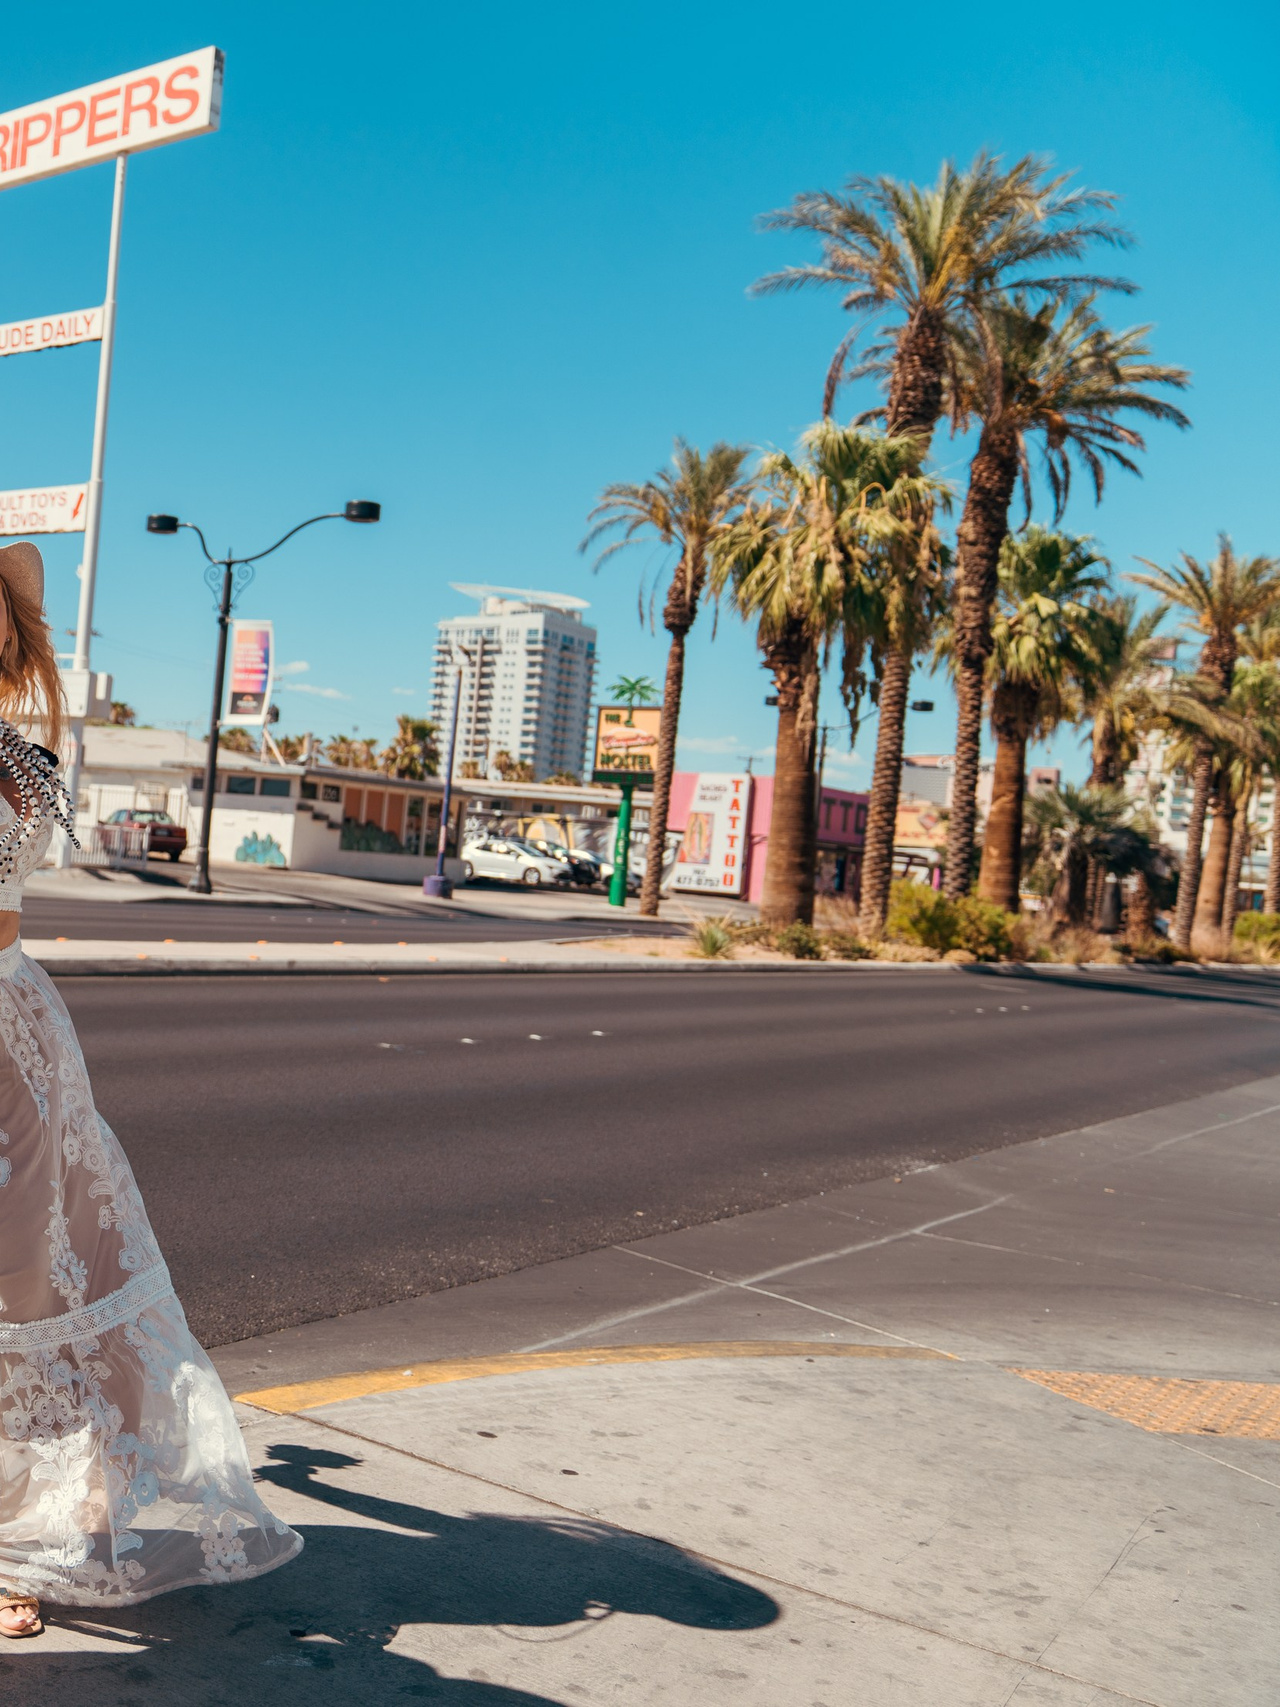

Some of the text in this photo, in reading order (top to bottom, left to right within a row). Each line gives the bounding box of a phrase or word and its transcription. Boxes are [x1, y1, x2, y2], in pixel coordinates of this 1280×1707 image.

[41, 313, 96, 342] DAILY
[30, 491, 68, 508] TOYS
[723, 780, 743, 886] TATTOO
